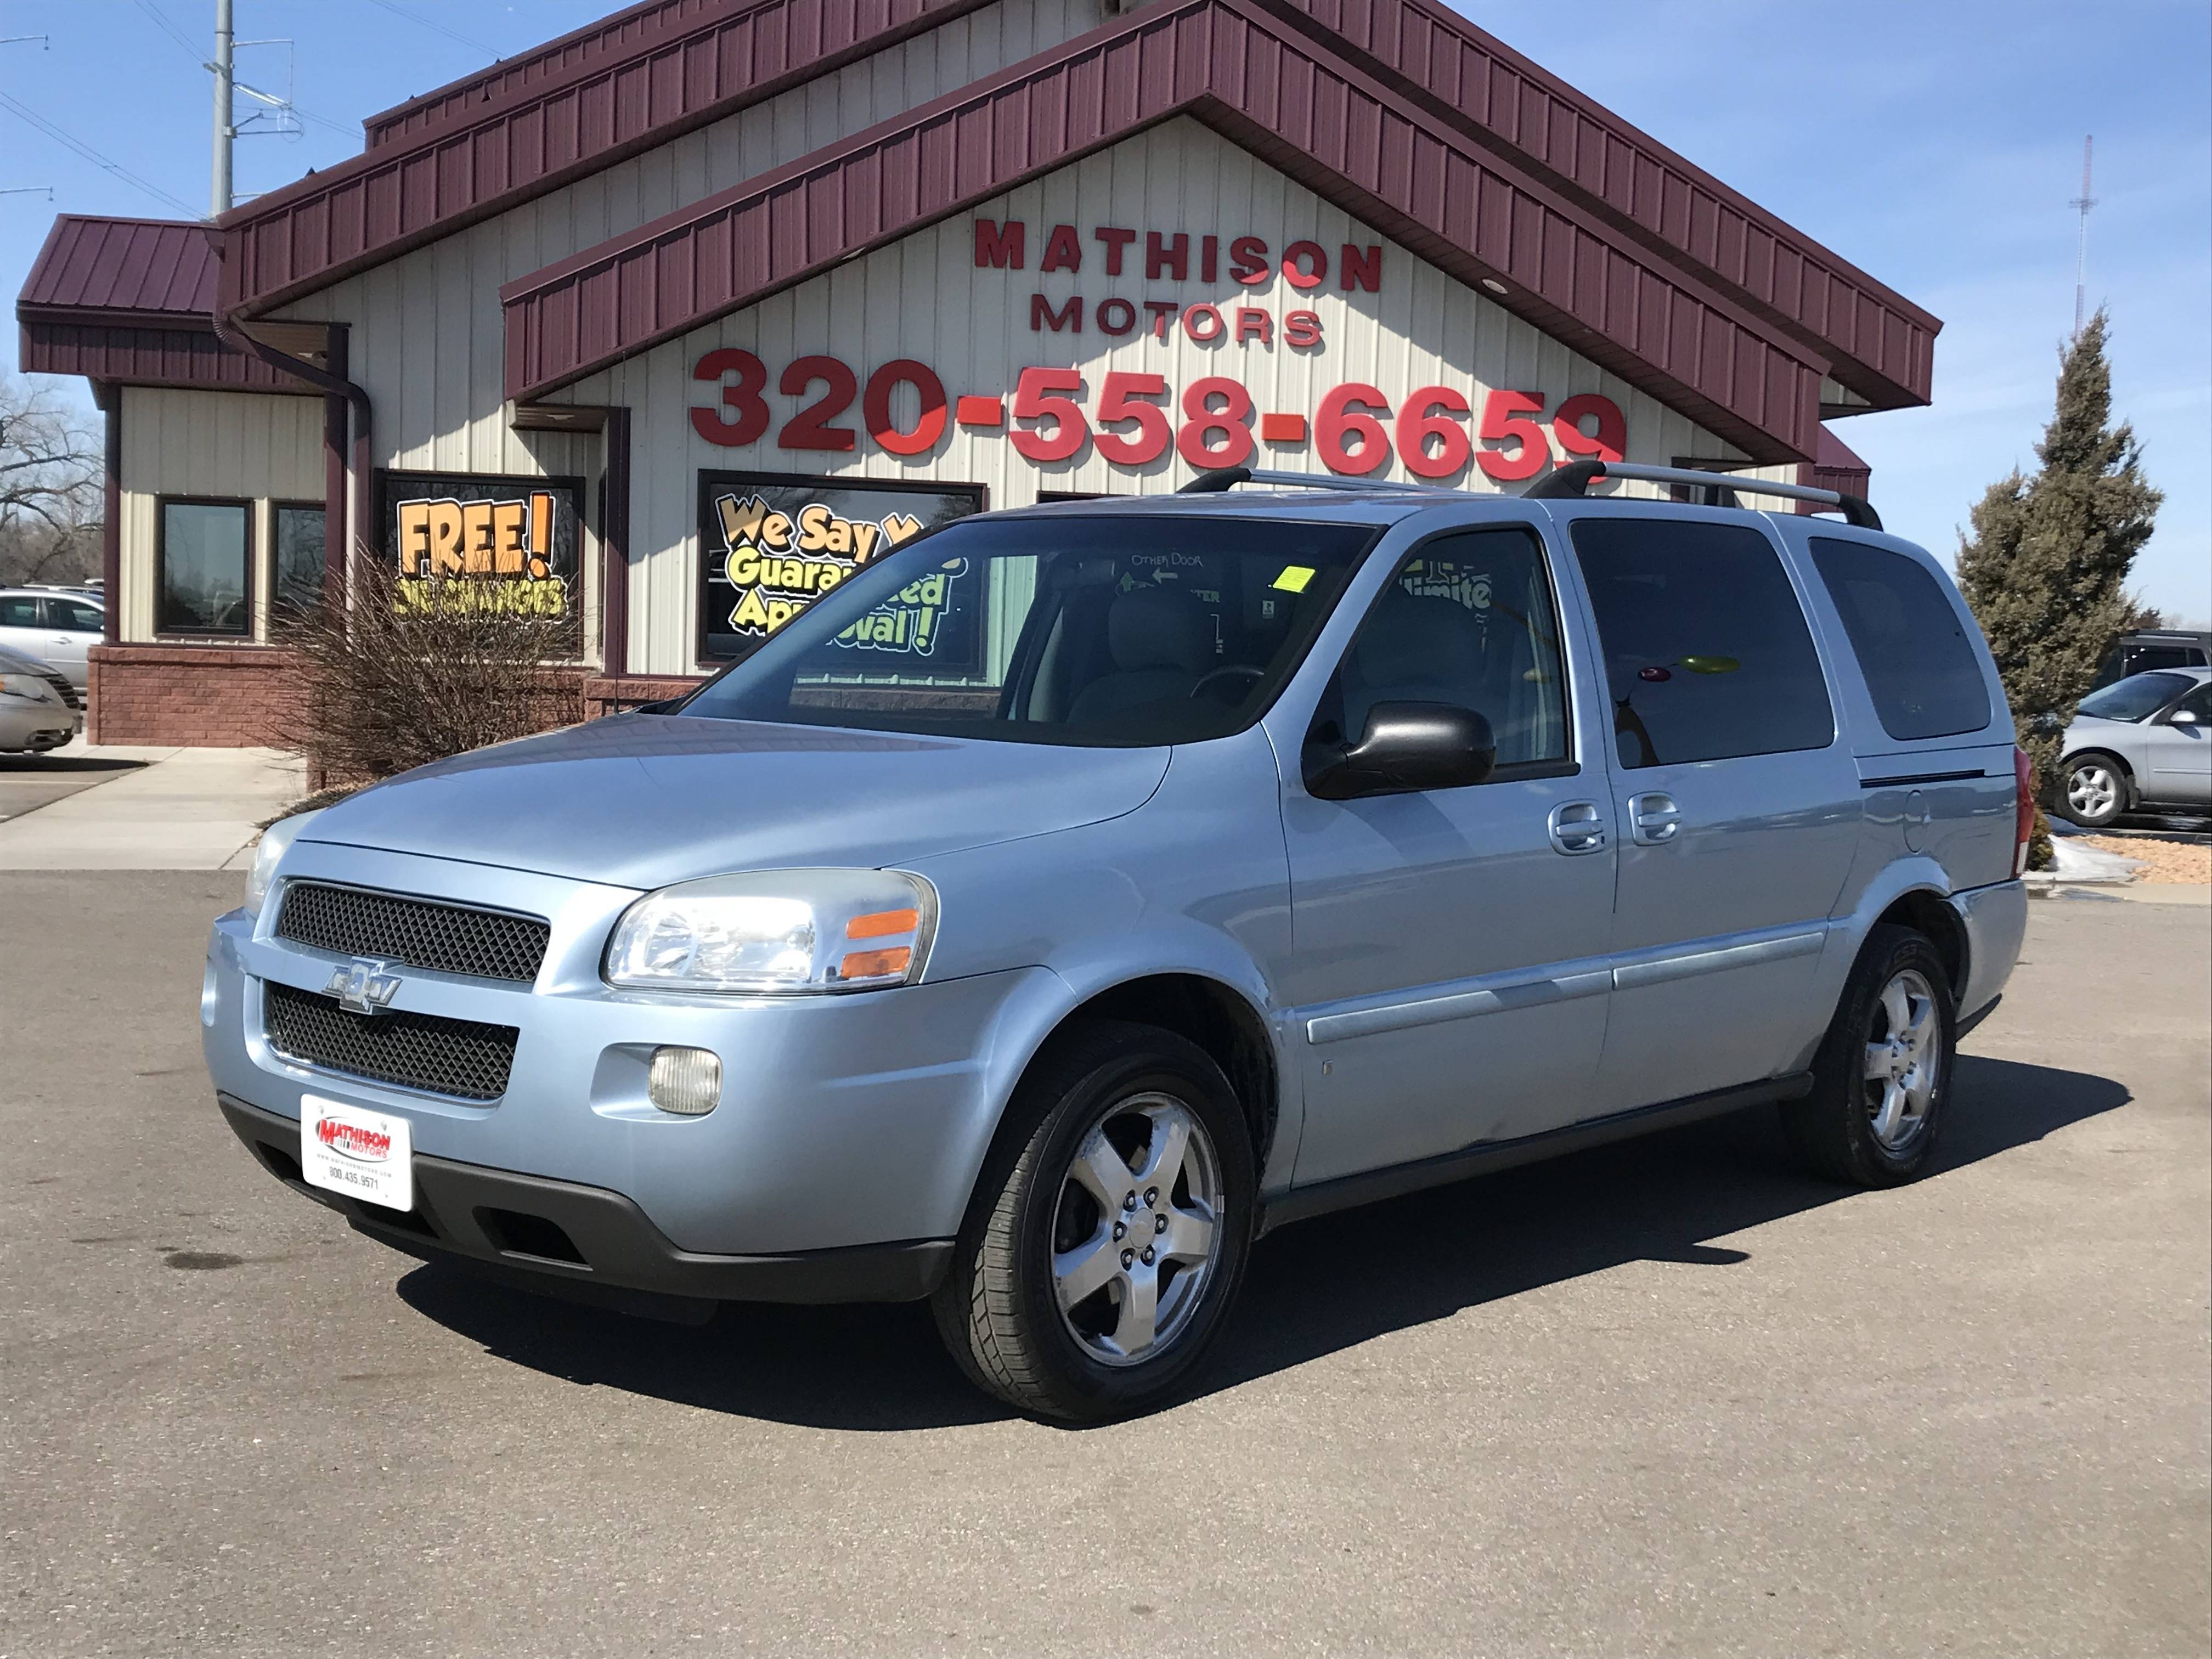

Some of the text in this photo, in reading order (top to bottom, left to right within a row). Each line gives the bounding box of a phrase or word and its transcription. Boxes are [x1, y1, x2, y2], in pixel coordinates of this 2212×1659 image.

[974, 218, 1382, 292] MATHISON
[1030, 293, 1322, 348] MOTORS
[690, 348, 1627, 483] 320-558-6659
[400, 494, 550, 577] FREE!
[720, 497, 789, 546] We
[797, 506, 877, 563] Say
[1131, 552, 1203, 567] OTHER DOOR
[320, 1119, 390, 1150] MATHISON
[350, 1143, 387, 1159] MOTORS
[329, 1166, 379, 1189] 800.435.9571
